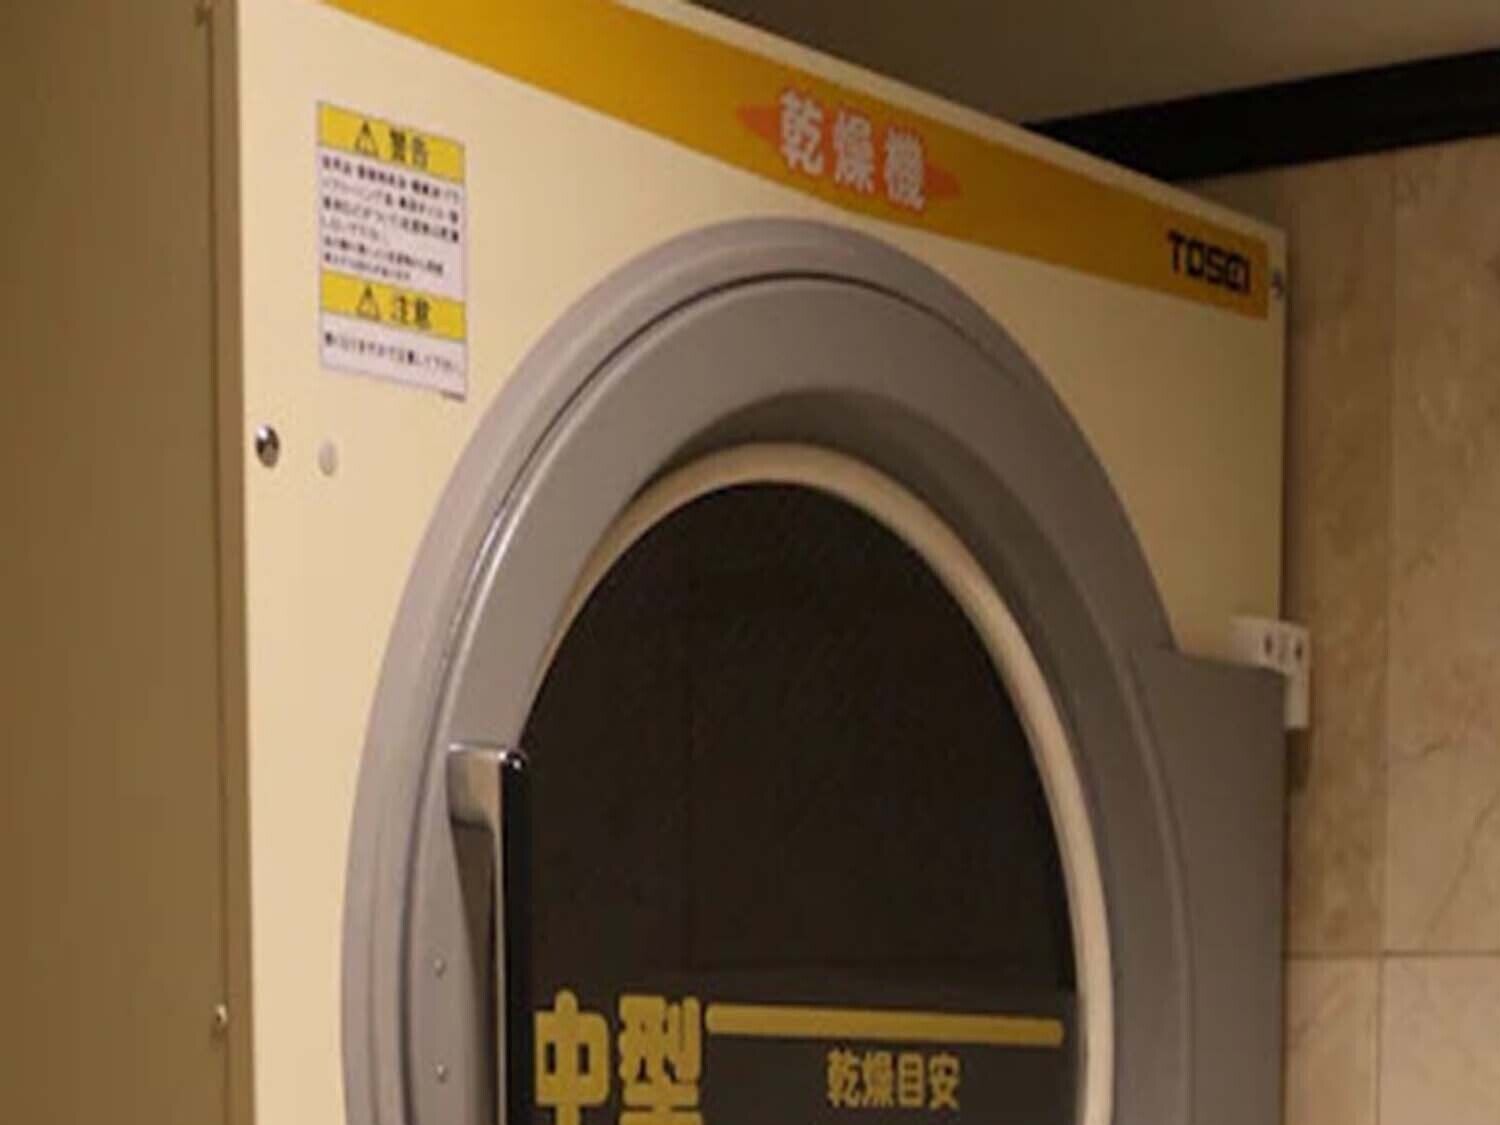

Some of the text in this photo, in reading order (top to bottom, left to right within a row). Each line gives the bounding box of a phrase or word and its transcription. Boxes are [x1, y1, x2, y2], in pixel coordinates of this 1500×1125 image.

[779, 88, 926, 213] 乾燥機
[826, 1048, 961, 1111] 乾燥目安
